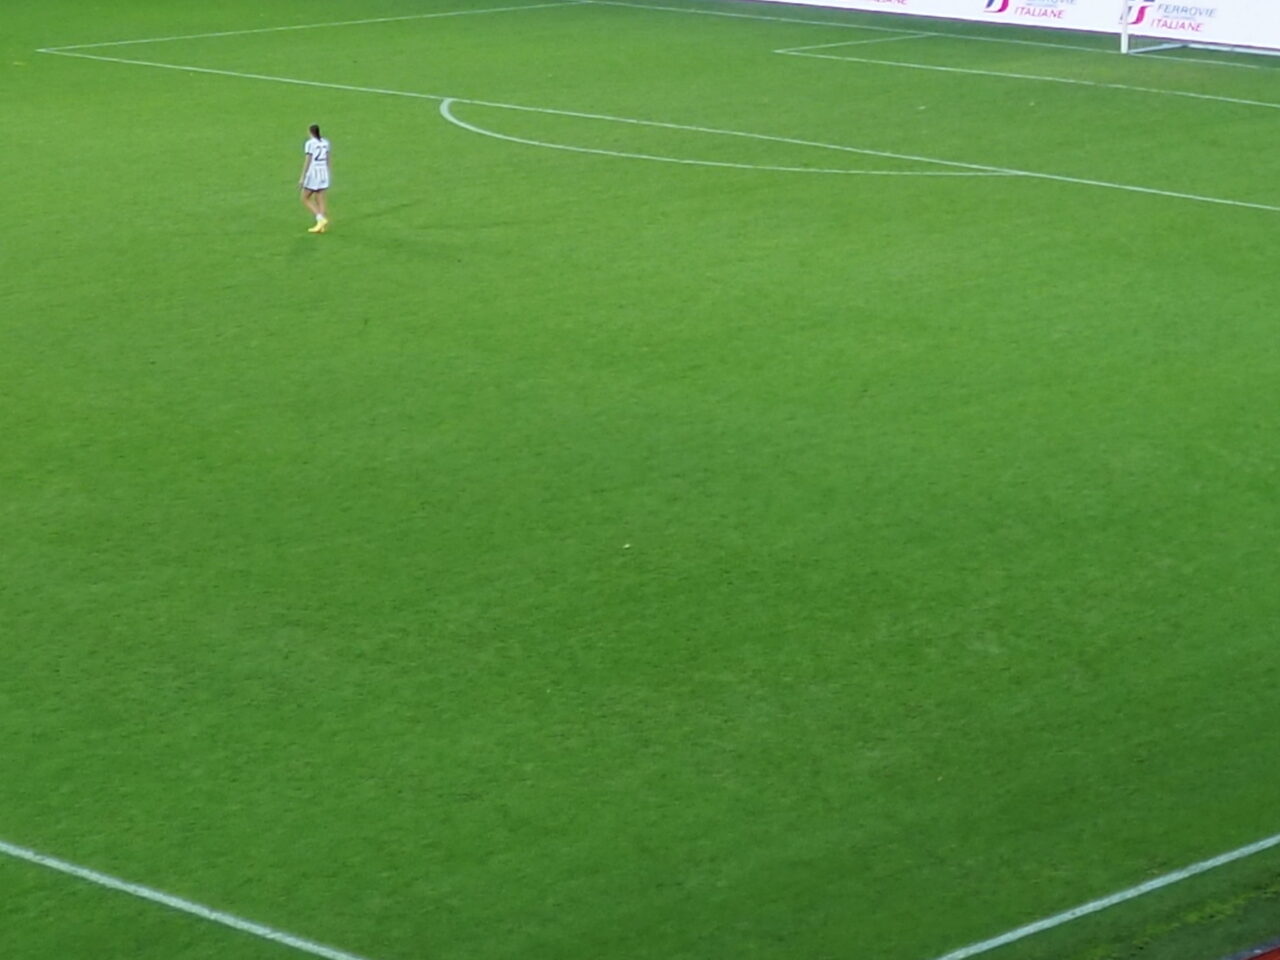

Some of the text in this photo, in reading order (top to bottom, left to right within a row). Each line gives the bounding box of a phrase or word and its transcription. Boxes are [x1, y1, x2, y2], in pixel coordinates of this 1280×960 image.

[1017, 7, 1065, 20] ITALIANE
[1158, 4, 1214, 19] FERROVIE
[1151, 19, 1204, 33] ITALIANE
